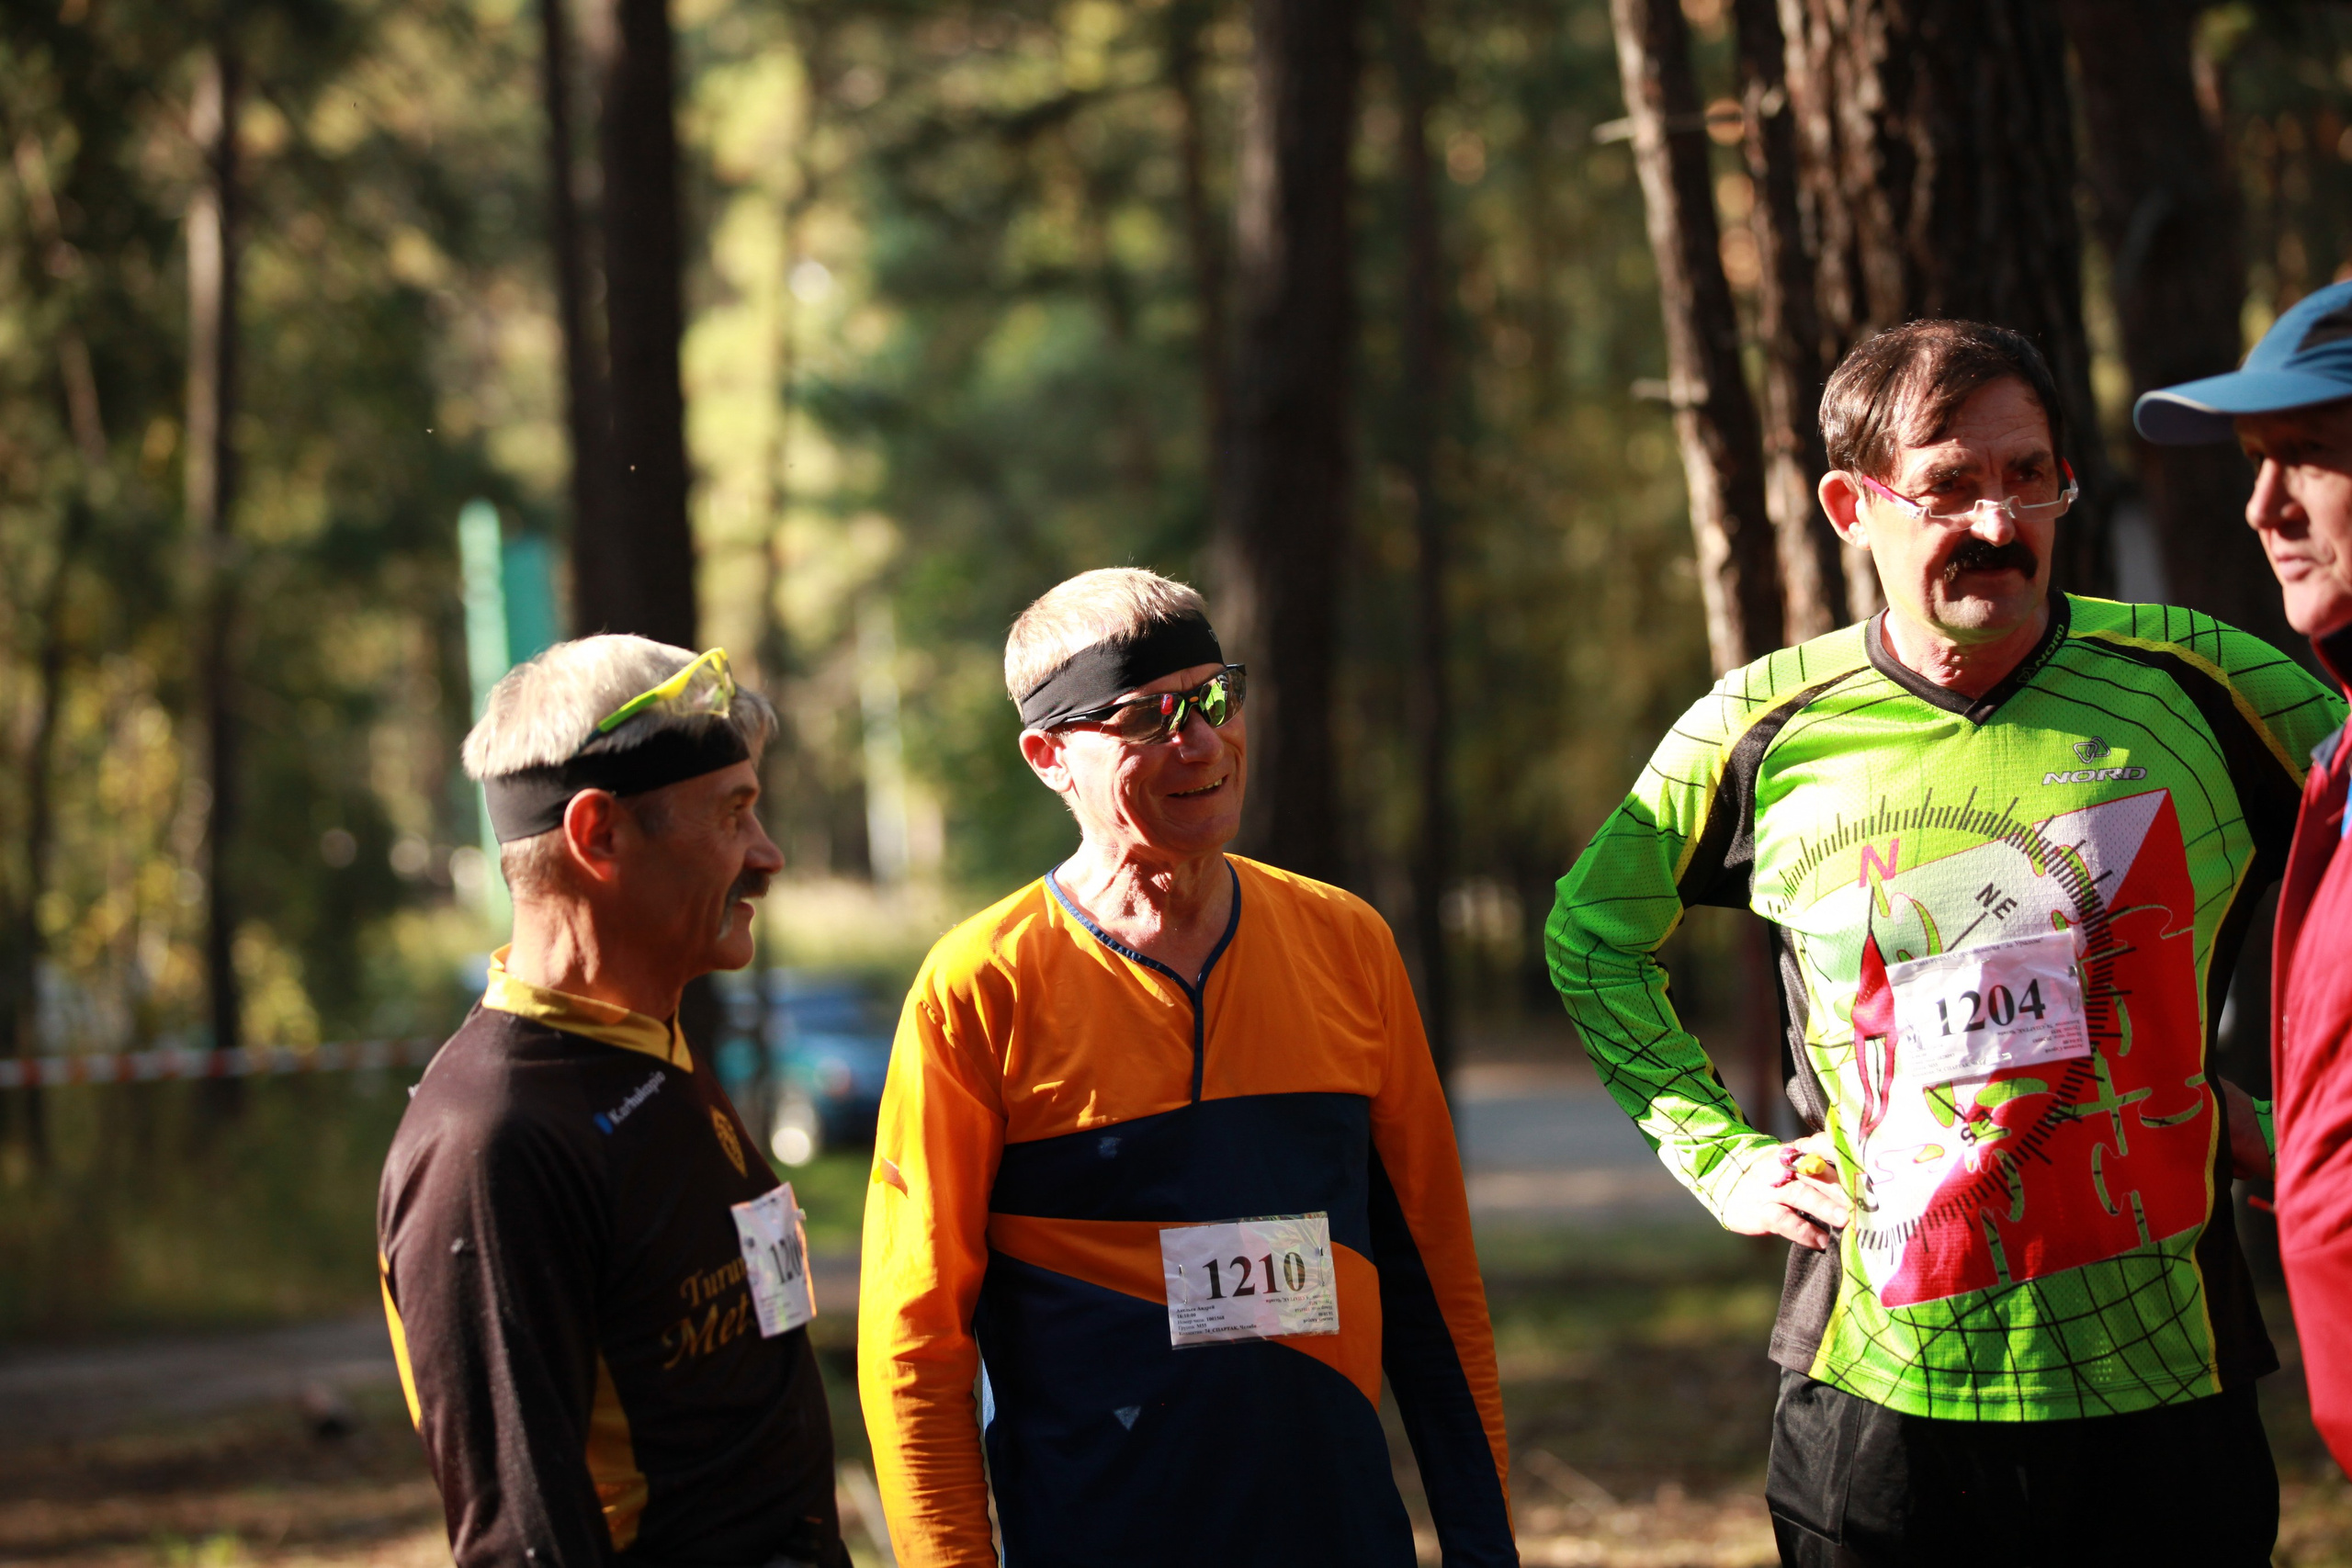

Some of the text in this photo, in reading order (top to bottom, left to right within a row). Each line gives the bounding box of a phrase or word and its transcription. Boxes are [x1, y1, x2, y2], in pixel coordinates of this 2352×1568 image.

[2035, 624, 2064, 668] NORD
[2042, 766, 2147, 786] NORD
[1859, 837, 1900, 888] N
[1974, 882, 2018, 920] NE
[1936, 978, 2047, 1037] 1204
[1202, 1251, 1306, 1301] 1210
